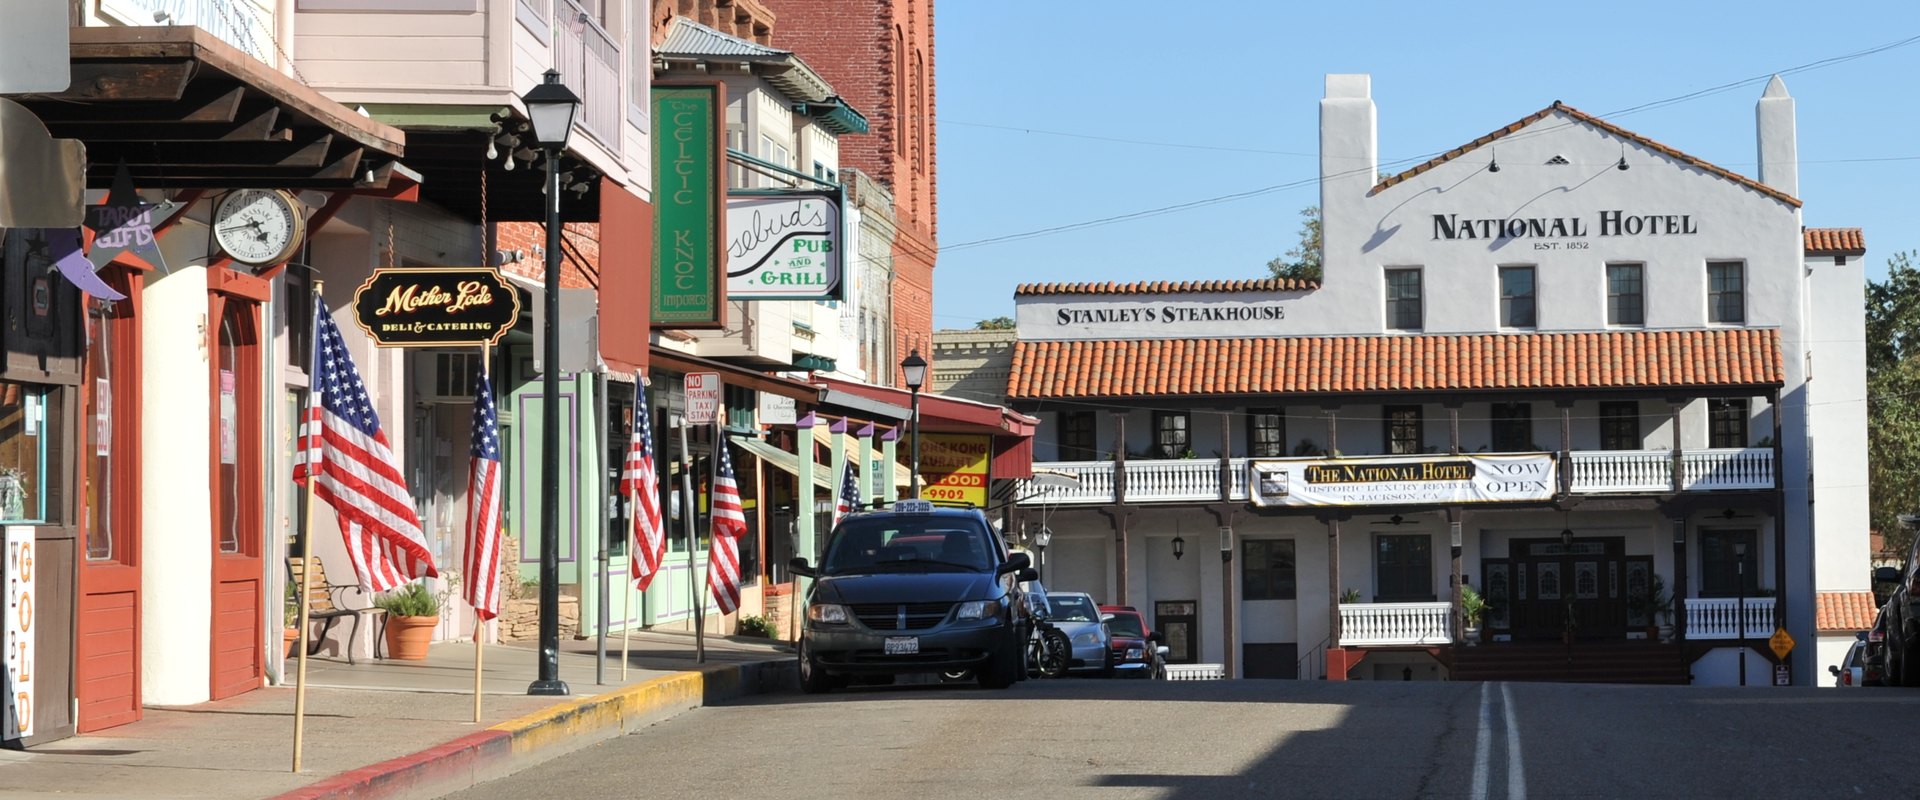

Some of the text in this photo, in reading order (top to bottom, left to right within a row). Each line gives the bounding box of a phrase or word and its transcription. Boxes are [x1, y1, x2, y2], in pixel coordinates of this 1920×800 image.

[93, 206, 151, 227] TAROT
[1430, 210, 1698, 240] NATIONAL HOTEL
[95, 224, 152, 248] GIFTS
[793, 239, 834, 253] PUB
[1533, 241, 1590, 250] EST. 1852
[788, 257, 812, 267] AND
[761, 271, 828, 285] GRILL
[375, 281, 494, 316] Mother Lode
[1057, 305, 1285, 325] STANLEY'S STEAKHOUSE
[413, 322, 427, 333] &
[427, 322, 491, 331] CATERING
[690, 376, 701, 387] NO
[688, 390, 717, 399] PARKING
[691, 411, 717, 420] STAND
[919, 443, 986, 455] ONG KONG
[1309, 463, 1471, 483] THE NATIONAL HOTEL
[1490, 463, 1544, 475] NOW
[940, 475, 981, 486] FOOD
[1486, 480, 1547, 493] OPEN
[1304, 482, 1477, 493] HISTORIC LUXURY REVIVED
[18, 541, 32, 732] GOLD
